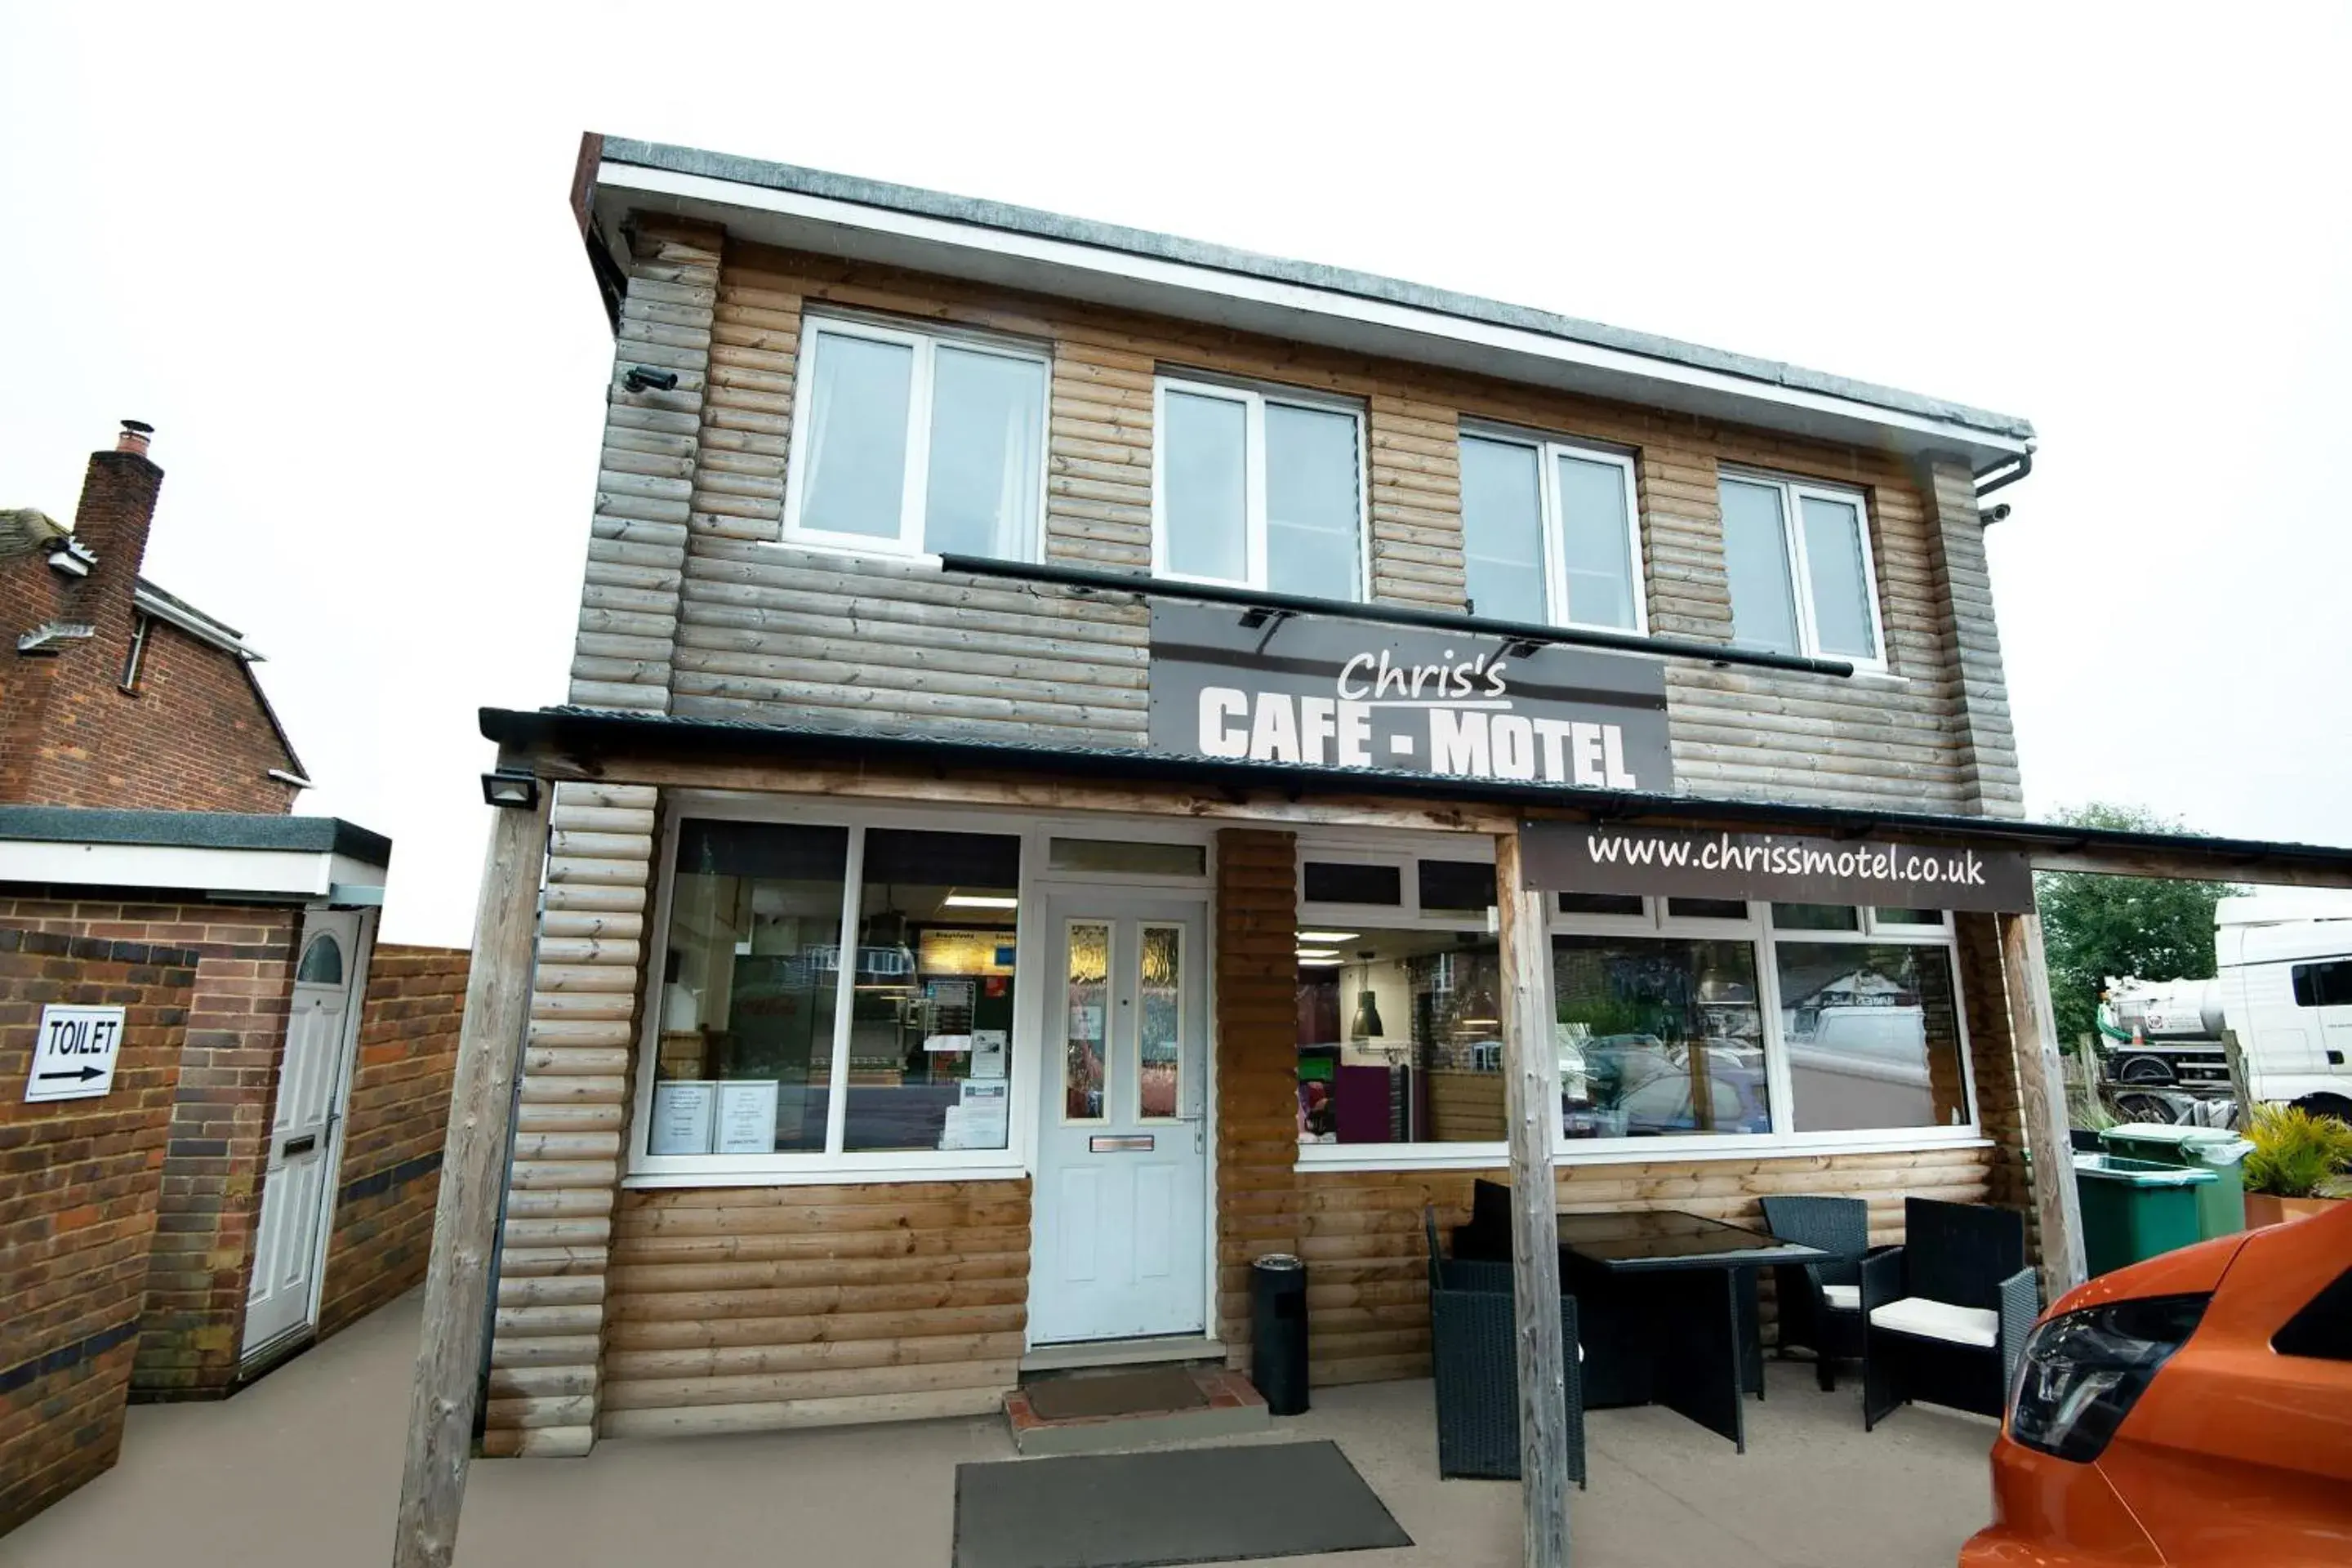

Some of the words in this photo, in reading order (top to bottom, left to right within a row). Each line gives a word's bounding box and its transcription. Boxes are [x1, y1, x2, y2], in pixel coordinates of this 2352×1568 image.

[1337, 649, 1507, 700] Chris's
[1199, 686, 1372, 766] CAFE
[1429, 708, 1637, 790] MOTEL
[1588, 833, 1986, 886] www.chrissmotel.co.uk
[49, 1020, 118, 1056] TOILET
